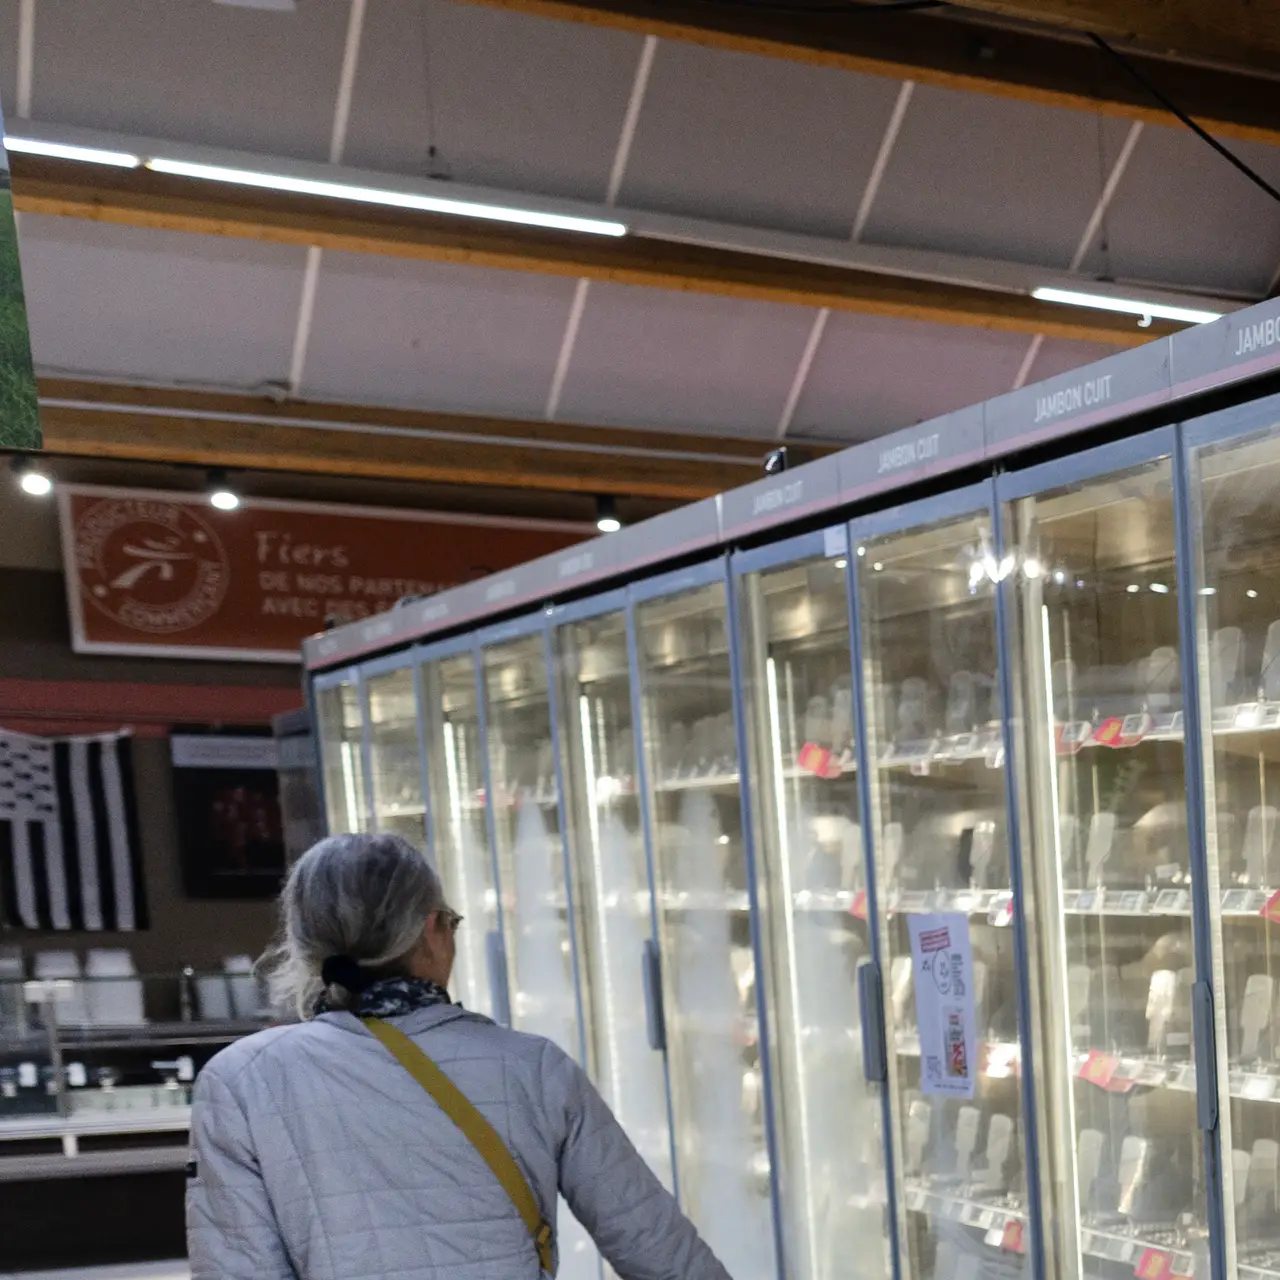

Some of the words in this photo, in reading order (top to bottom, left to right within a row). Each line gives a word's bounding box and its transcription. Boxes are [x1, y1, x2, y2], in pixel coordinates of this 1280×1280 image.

[1034, 384, 1083, 422] JAMBON
[1086, 373, 1112, 408] CUIT
[255, 530, 349, 567] Fiers
